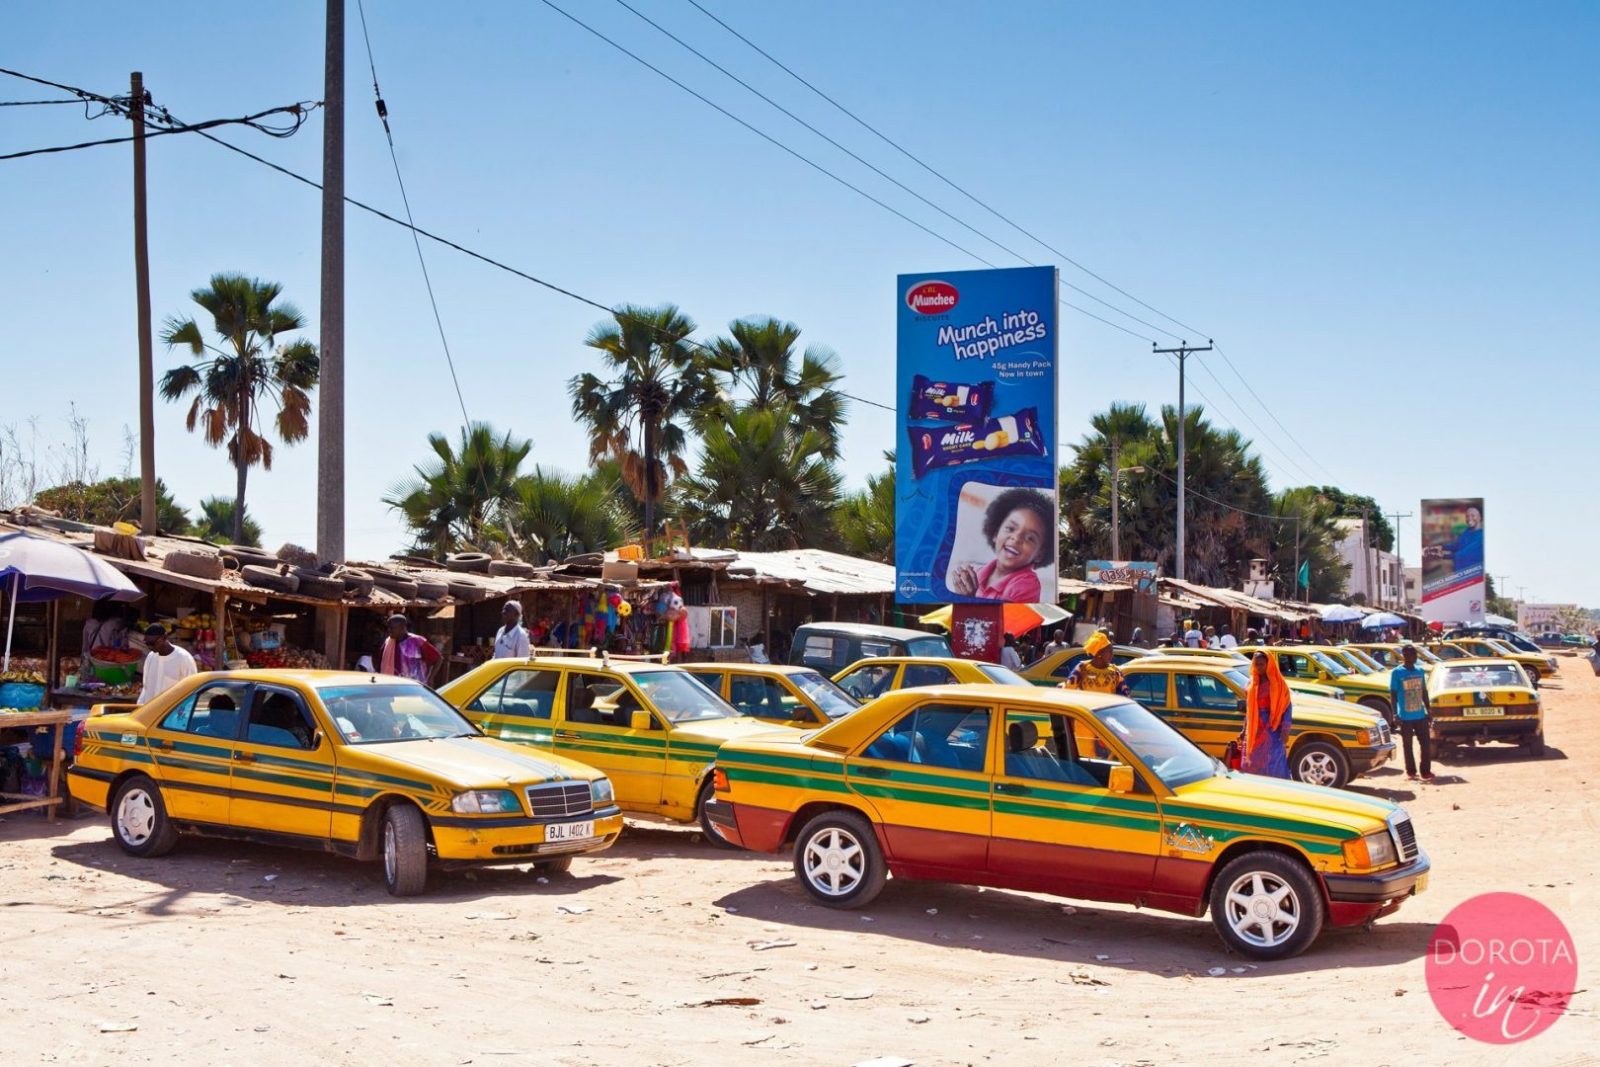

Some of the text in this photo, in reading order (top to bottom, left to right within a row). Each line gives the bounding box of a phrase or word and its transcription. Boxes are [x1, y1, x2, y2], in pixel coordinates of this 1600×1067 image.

[912, 293, 955, 306] Munchee
[938, 310, 1038, 345] Munch into
[954, 323, 1046, 360] happiness
[1008, 361, 1031, 369] Handy
[1033, 360, 1052, 368] Pack
[925, 386, 946, 396] Milk
[940, 431, 975, 445] Milk
[550, 822, 591, 839] BJL 1402 K
